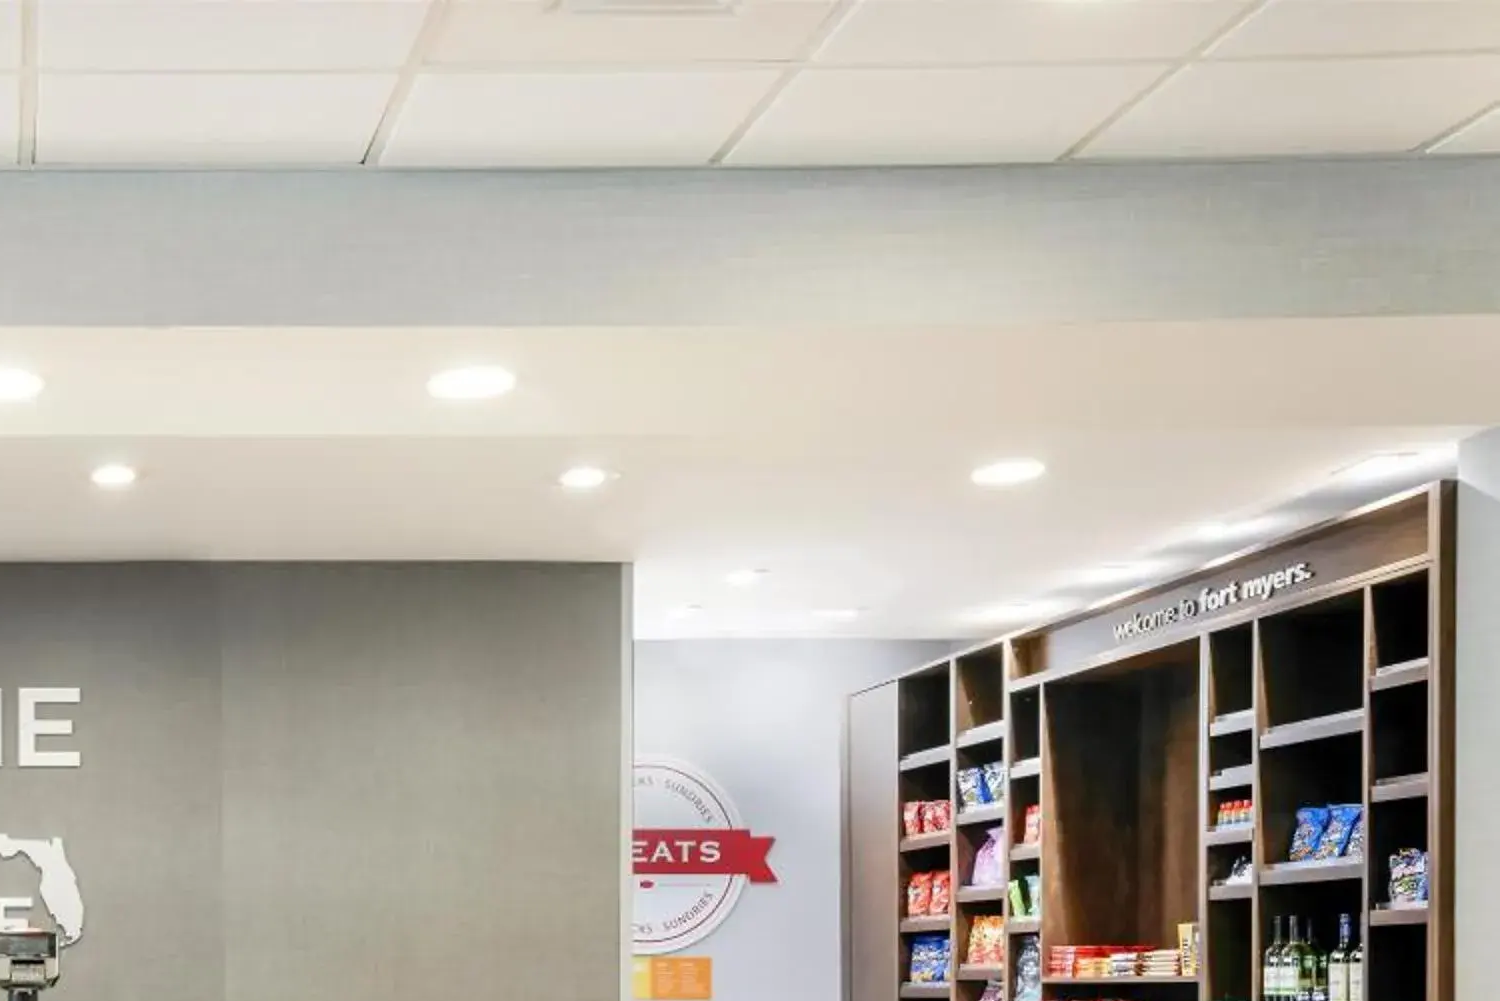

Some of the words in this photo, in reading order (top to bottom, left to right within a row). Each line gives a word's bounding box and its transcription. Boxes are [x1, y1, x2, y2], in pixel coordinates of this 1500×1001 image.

[1113, 607, 1178, 640] welcome
[1180, 599, 1196, 619] to
[1200, 583, 1238, 612] fort
[1242, 563, 1313, 600] myers.
[663, 890, 713, 931] SUNDRIES
